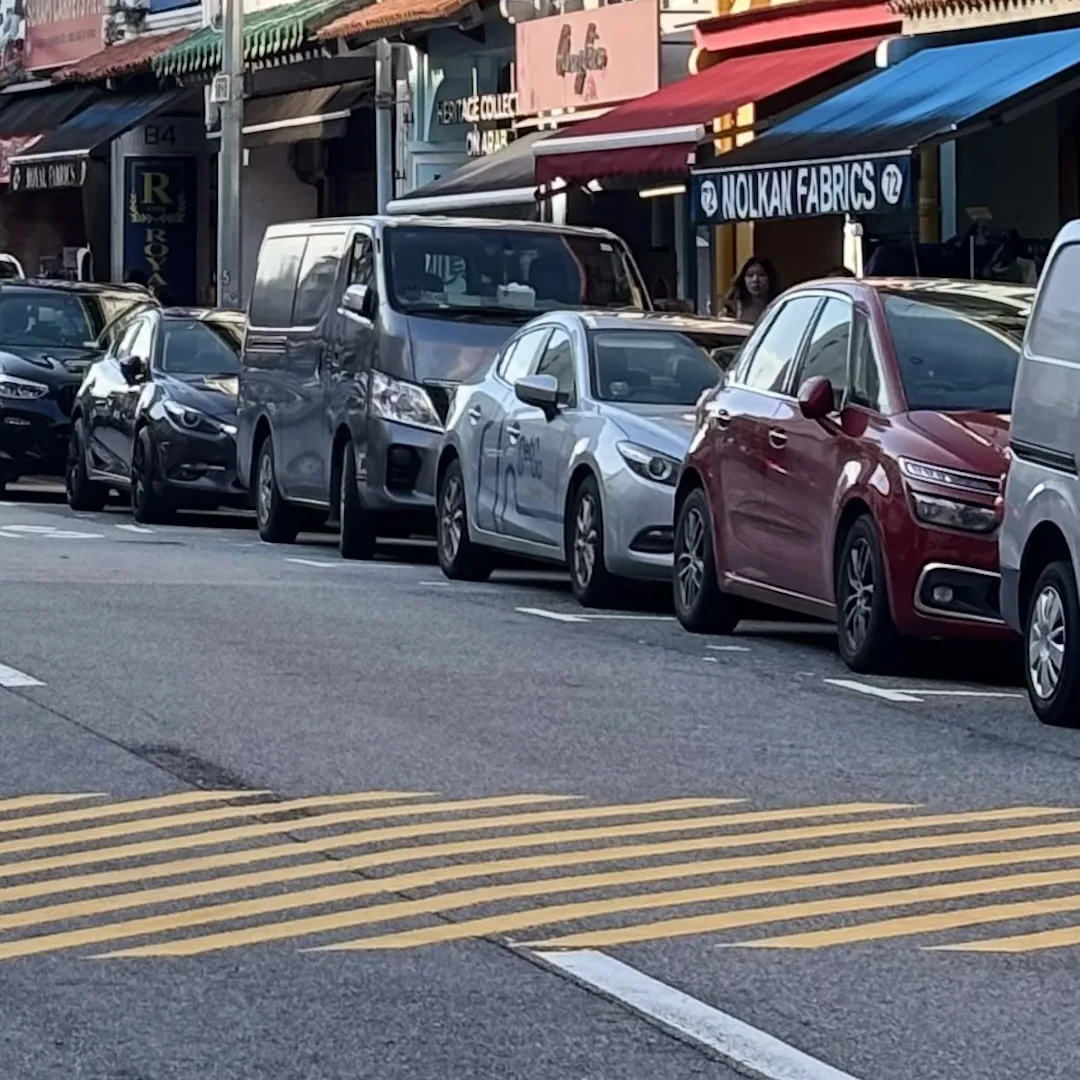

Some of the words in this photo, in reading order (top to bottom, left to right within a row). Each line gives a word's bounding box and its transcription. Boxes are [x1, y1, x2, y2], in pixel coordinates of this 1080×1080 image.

[437, 96, 480, 124] HERITAGE
[141, 172, 173, 205] R
[722, 170, 793, 220] NOLKAN
[796, 161, 876, 214] FABRICS
